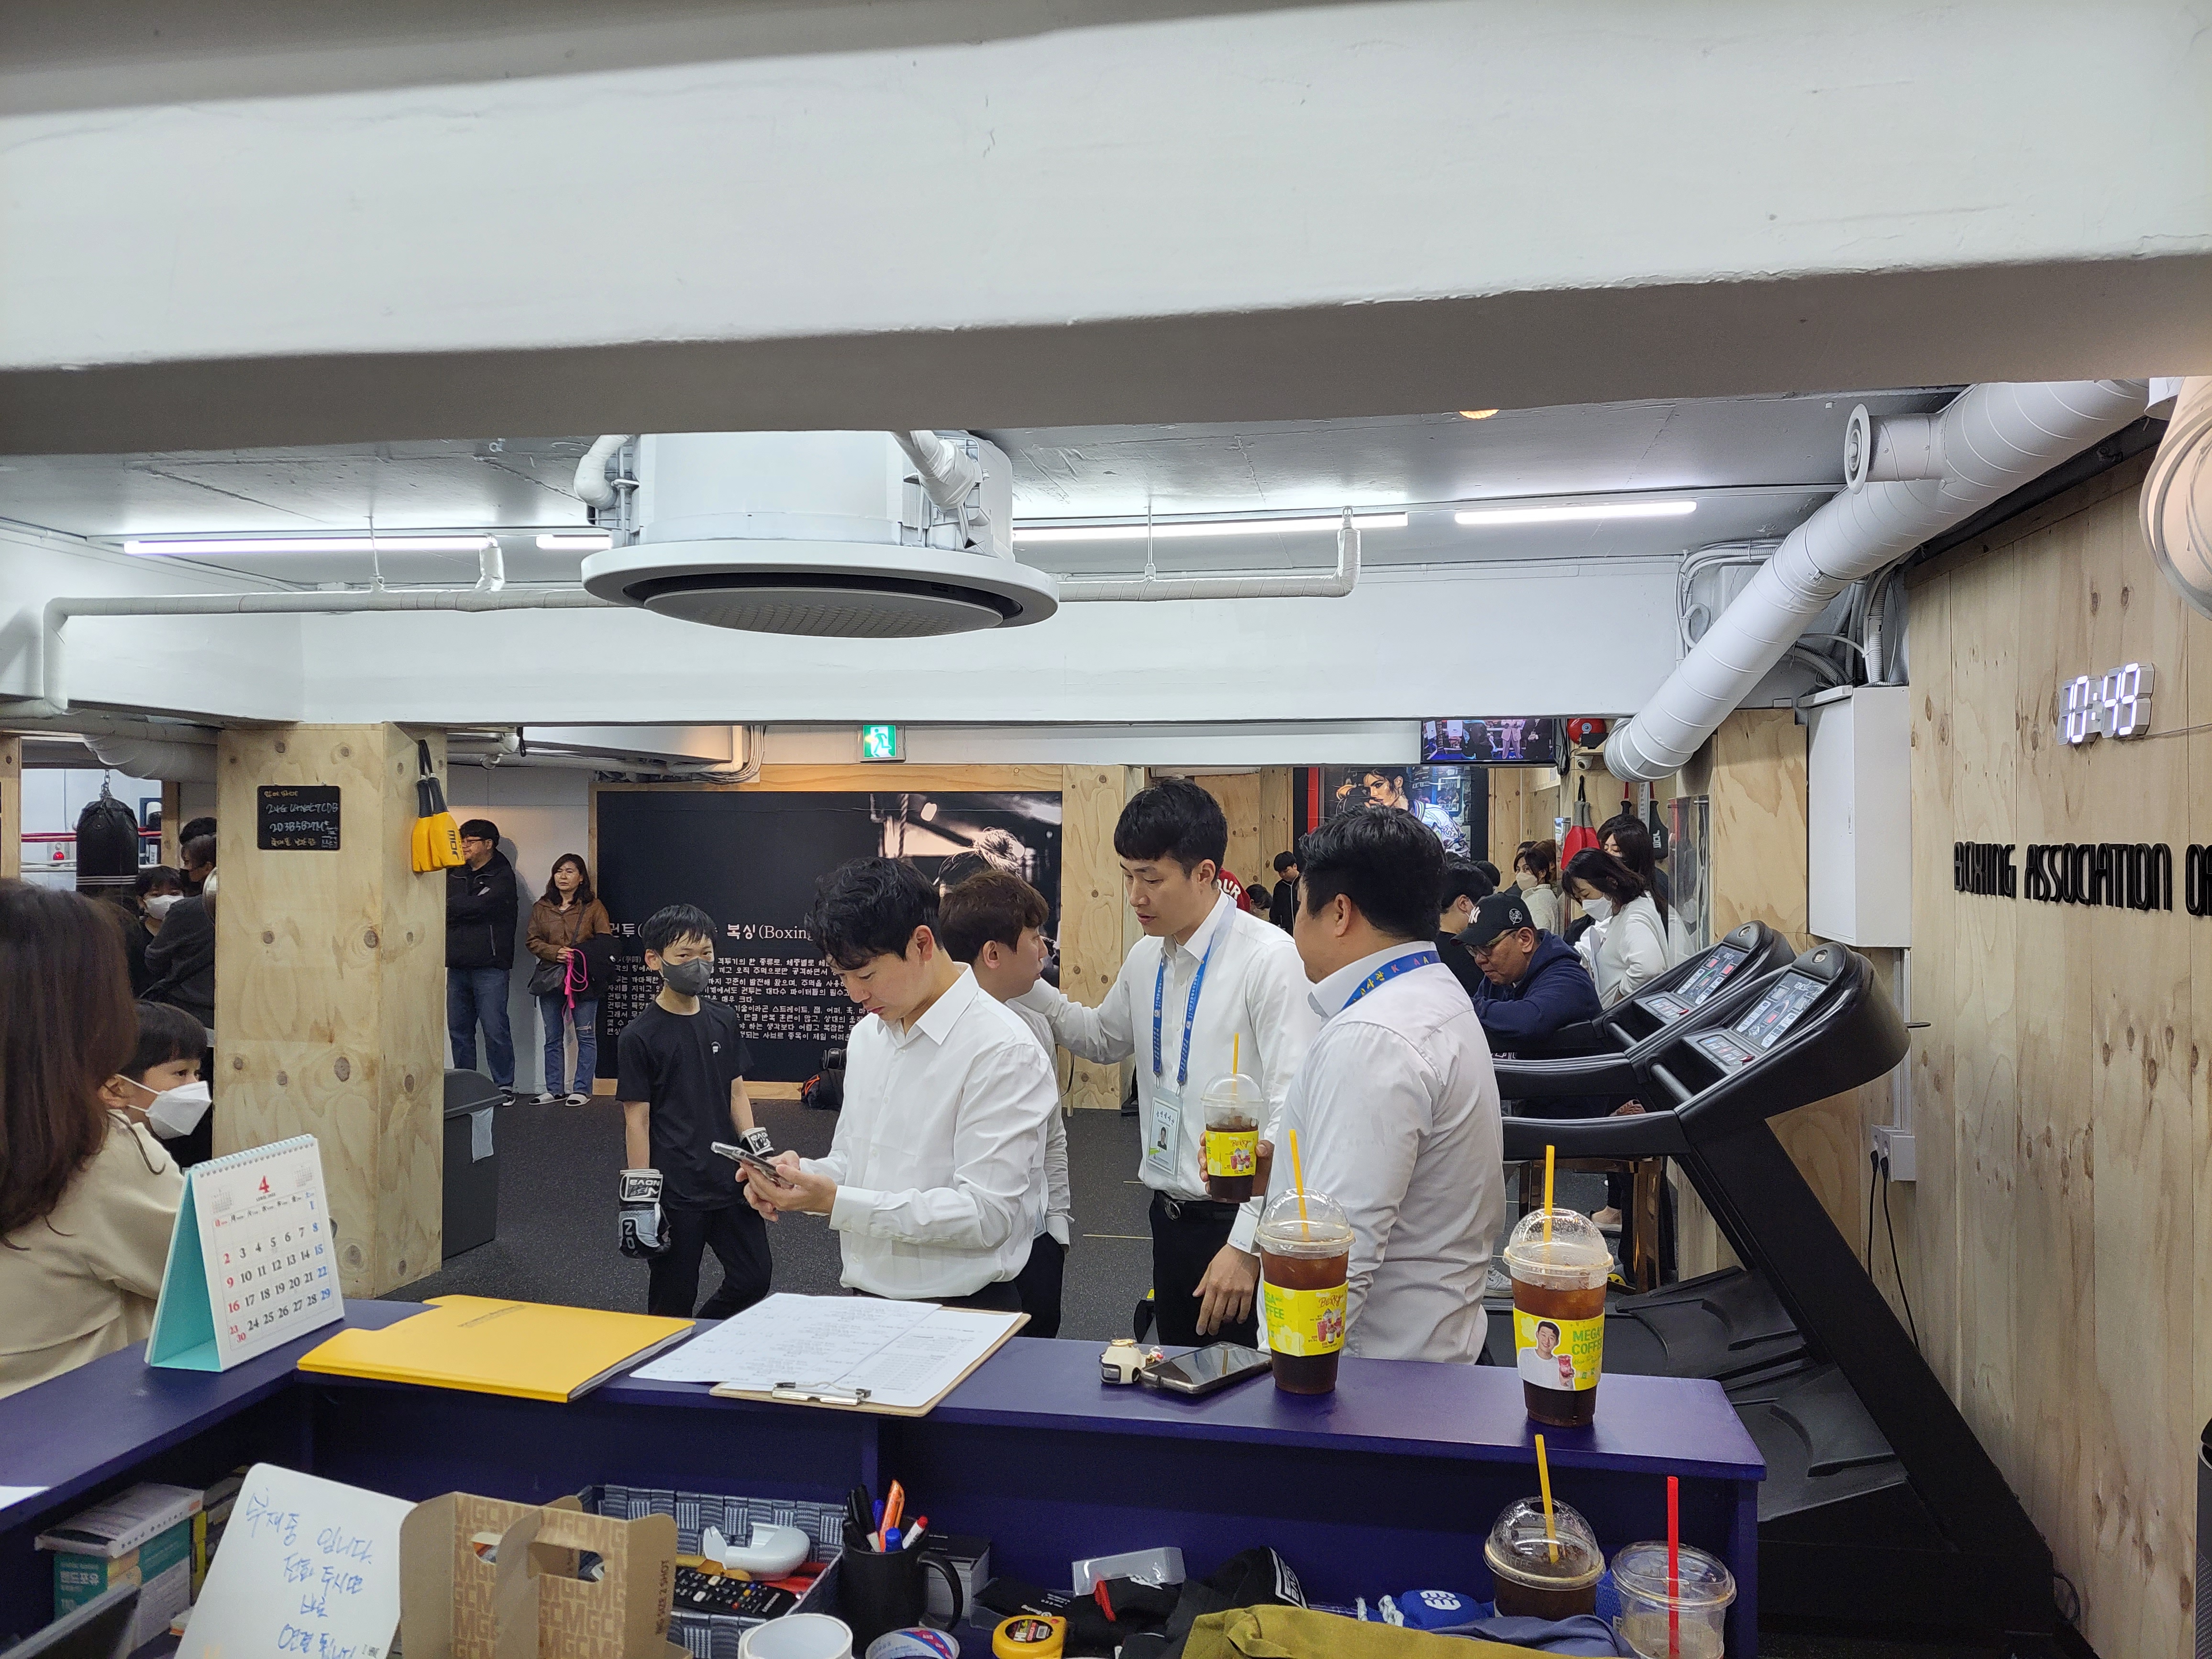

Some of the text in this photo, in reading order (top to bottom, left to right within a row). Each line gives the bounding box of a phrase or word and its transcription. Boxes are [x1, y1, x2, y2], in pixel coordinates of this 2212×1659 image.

[2068, 662, 2142, 744] 10:49
[1954, 841, 2016, 899] BOXING
[2024, 842, 2173, 912] ASSOCIATION
[753, 967, 788, 975] 주먹으로만
[790, 988, 826, 996] 파이터들의
[258, 1175, 270, 1194] 4
[310, 1201, 314, 1210] 1
[224, 1222, 319, 1265] 2 3 4 5 6 7 8
[227, 1243, 323, 1289] 9 10 11 12 13 14 15
[228, 1265, 328, 1314] 16 17 18 19 20 21 22
[247, 1317, 259, 1332] 24
[263, 1311, 274, 1325] 25
[278, 1305, 288, 1319] 26
[292, 1299, 303, 1313] 27
[307, 1293, 318, 1306] 28
